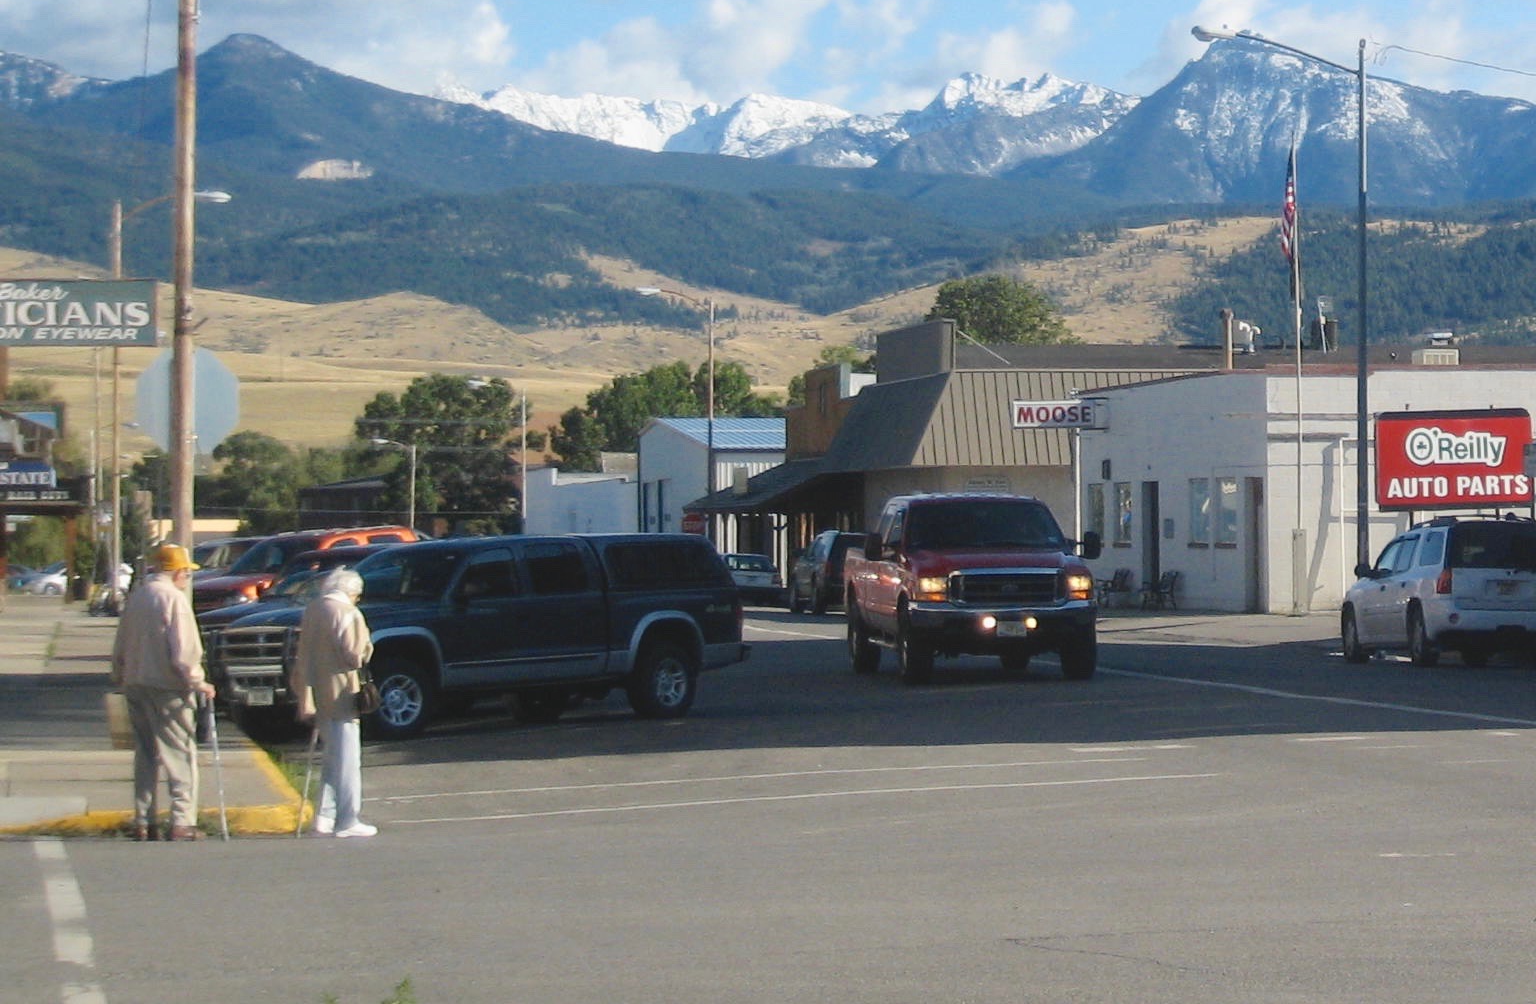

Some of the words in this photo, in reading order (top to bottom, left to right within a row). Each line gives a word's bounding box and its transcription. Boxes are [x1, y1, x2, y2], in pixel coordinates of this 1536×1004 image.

[0, 282, 69, 300] Baker
[0, 301, 150, 327] ICIANS
[33, 328, 138, 340] EYEWEAR
[1017, 406, 1092, 424] MOOSE
[1407, 428, 1505, 466] O'Reilly
[1387, 477, 1449, 499] AUTO
[1456, 474, 1529, 497] PARTS
